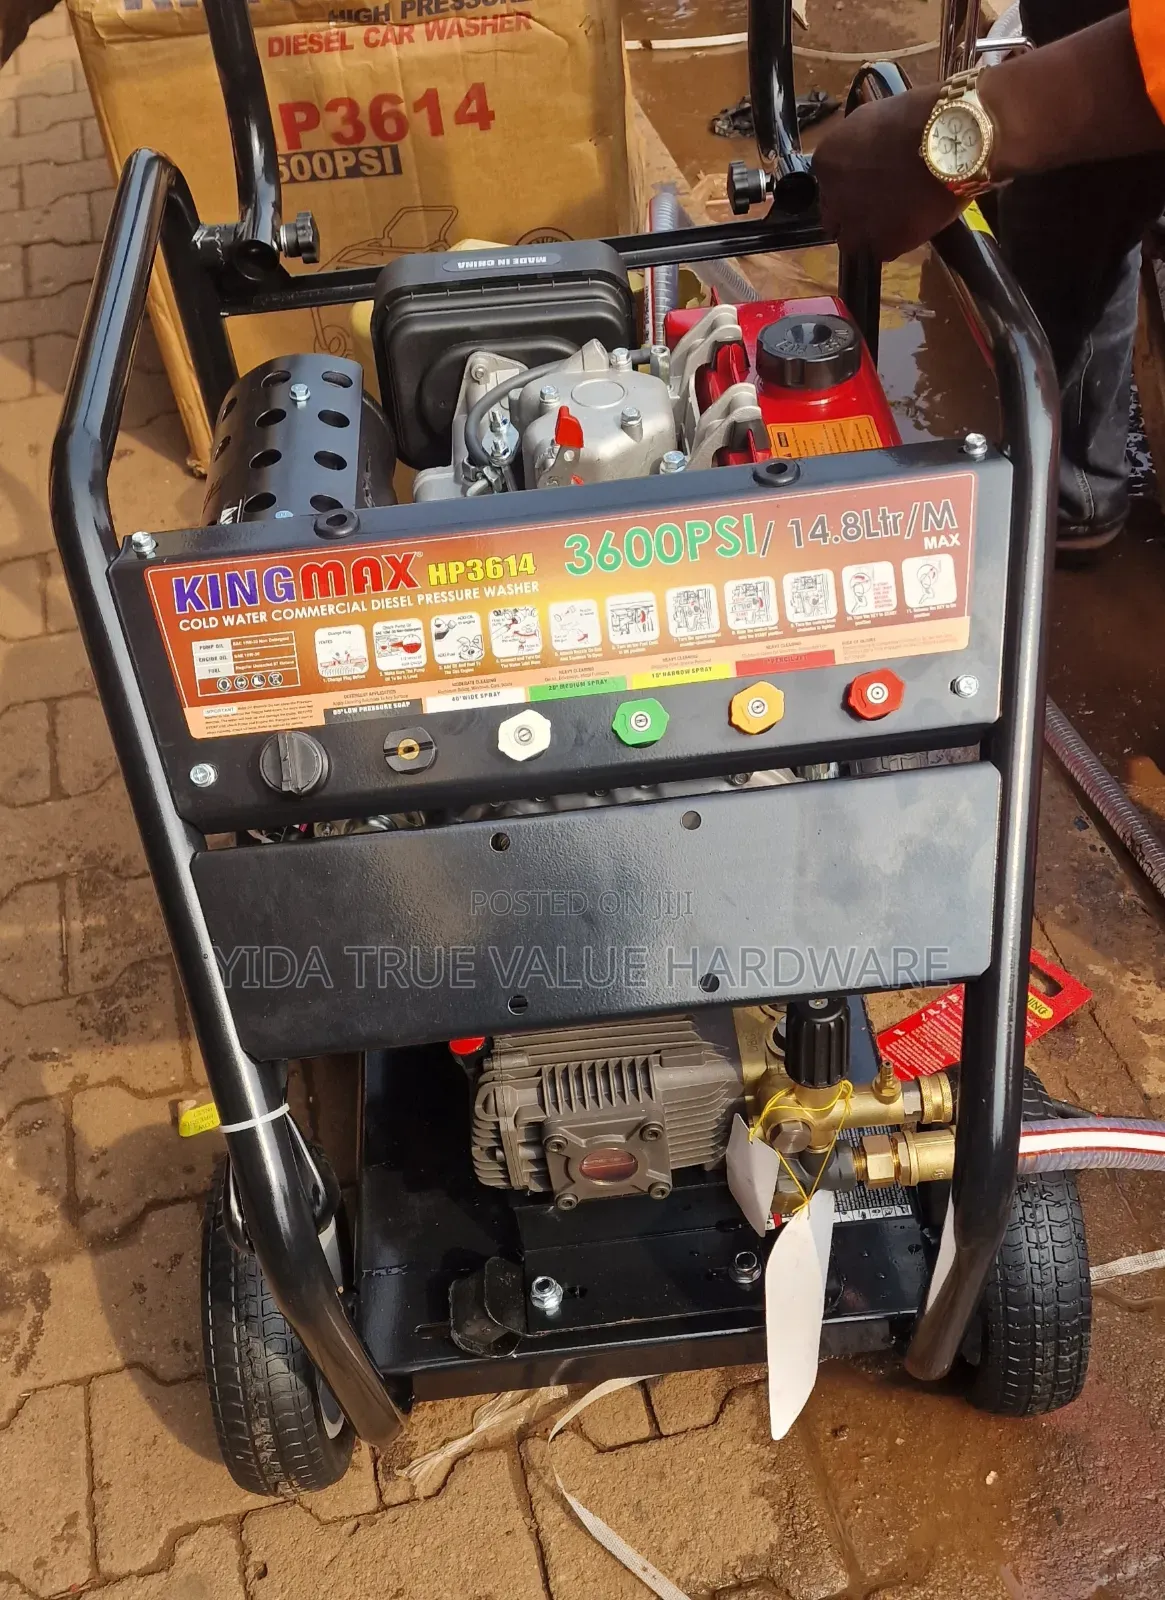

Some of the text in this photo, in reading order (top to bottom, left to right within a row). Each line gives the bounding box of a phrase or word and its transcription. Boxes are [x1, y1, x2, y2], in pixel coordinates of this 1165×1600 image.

[328, 5, 390, 25] HIGH
[267, 11, 533, 57] DIESEL CAR WASHER
[277, 82, 496, 150] P3614
[457, 256, 547, 269] MADE IN CHINA
[923, 533, 961, 550] MAX
[427, 552, 537, 587] HP3614
[179, 580, 540, 632] COLD WATER COMMERCIAL DIESEL PRESSURE WASHER
